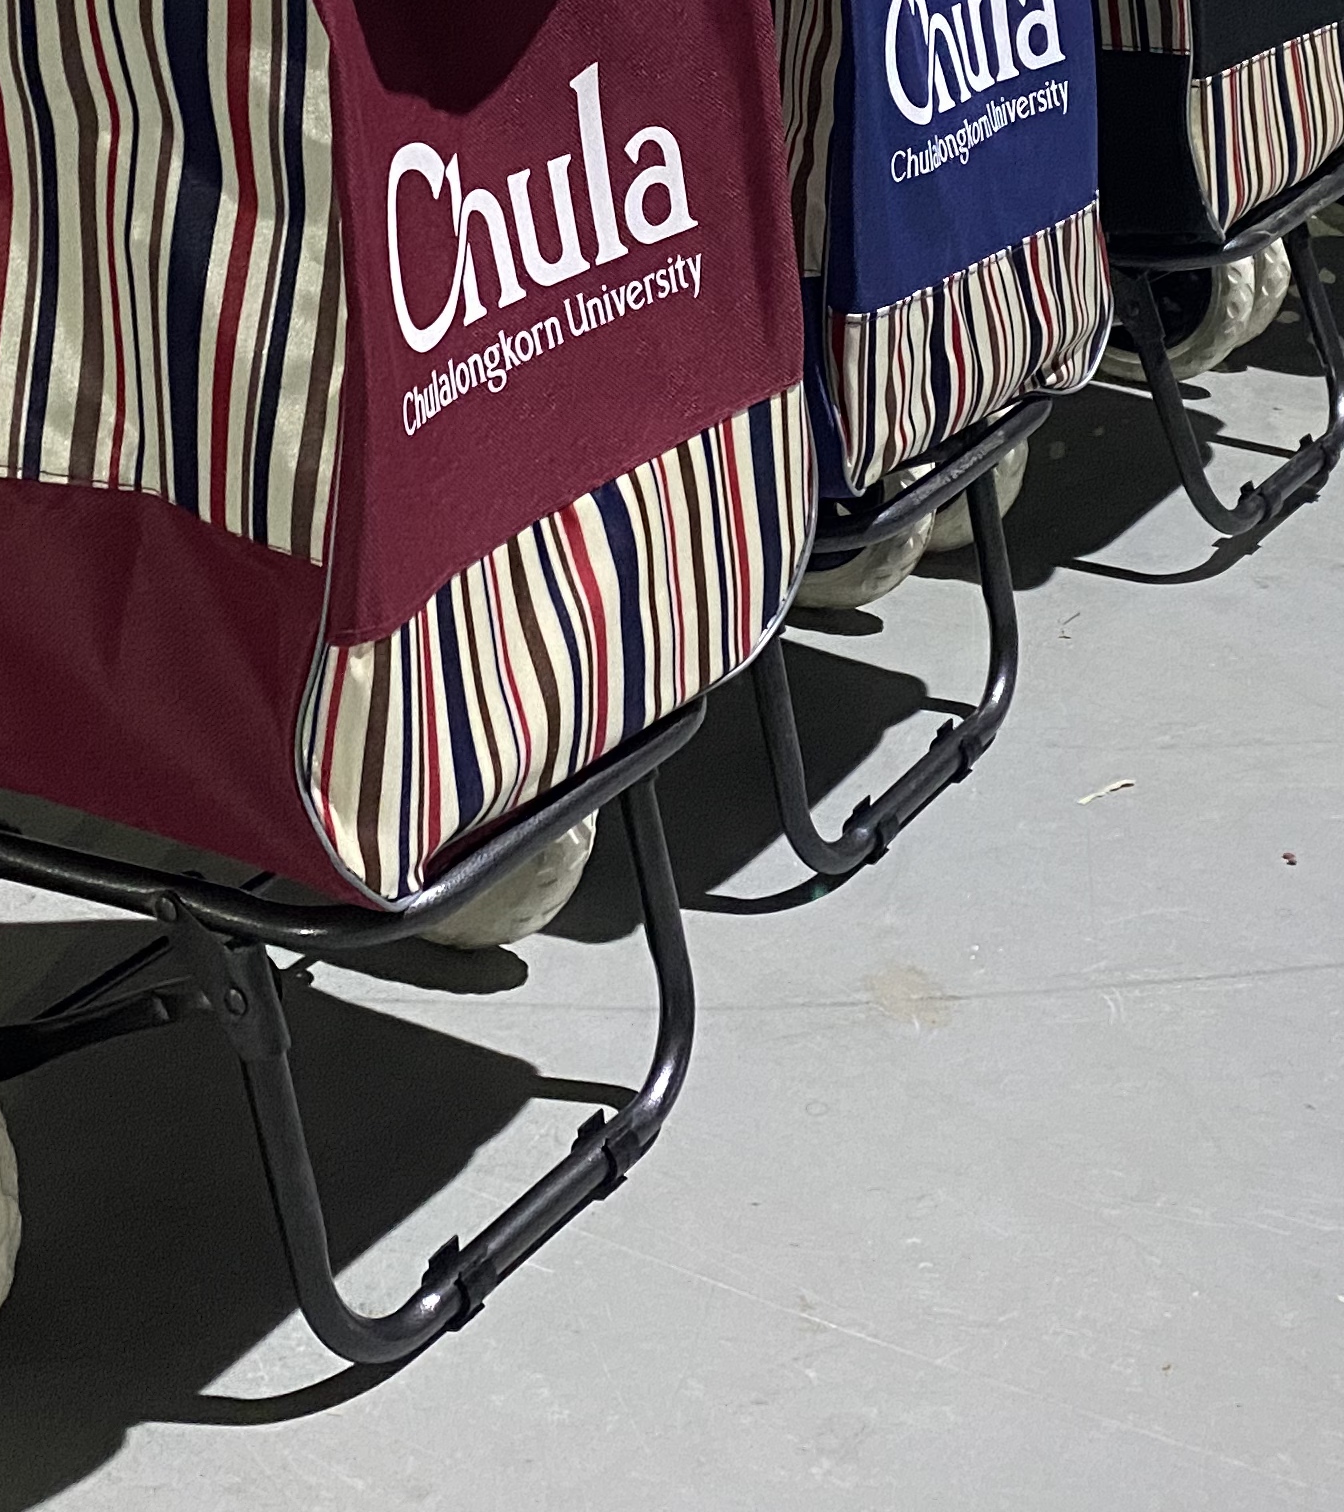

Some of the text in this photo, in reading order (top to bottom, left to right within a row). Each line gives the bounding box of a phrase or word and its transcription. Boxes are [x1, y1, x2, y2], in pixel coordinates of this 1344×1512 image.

[387, 61, 699, 354] Chula
[402, 253, 703, 436] Chulalongkorn University
